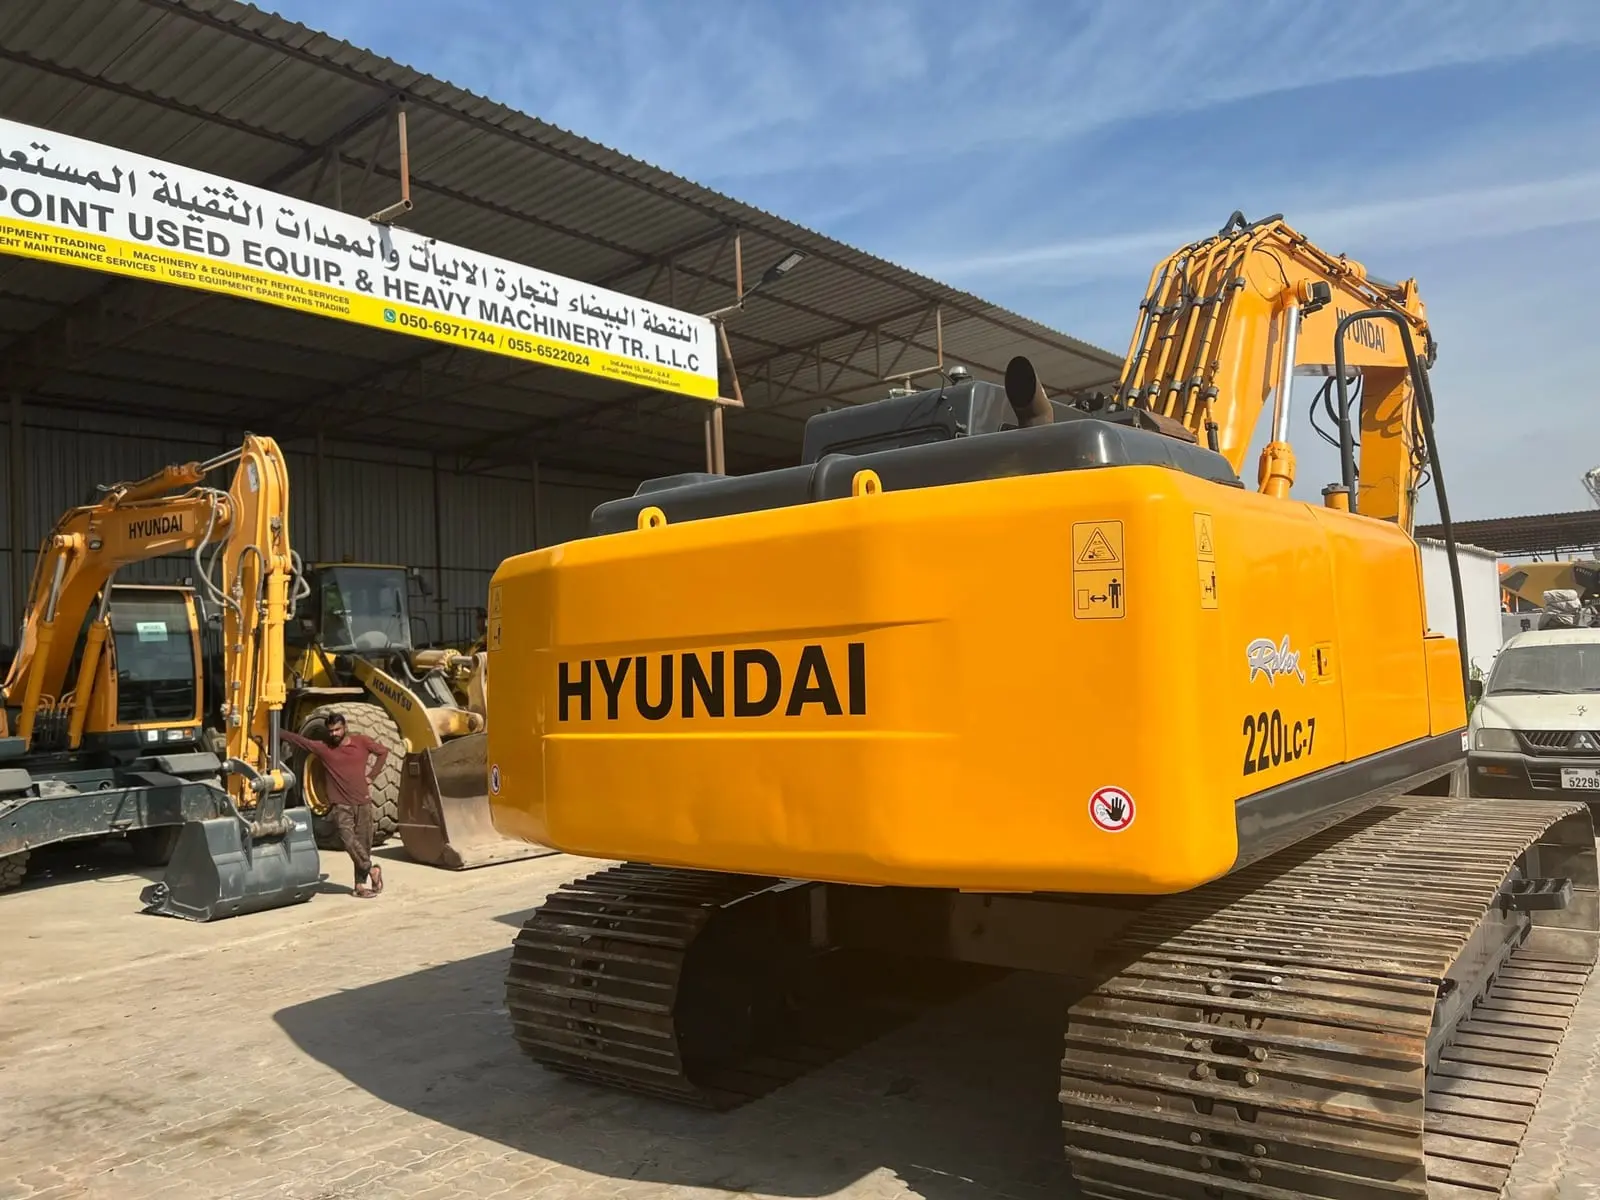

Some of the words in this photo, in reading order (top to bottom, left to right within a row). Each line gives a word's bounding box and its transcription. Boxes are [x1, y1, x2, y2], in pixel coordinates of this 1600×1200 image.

[149, 170, 263, 229] الثقيلة
[0, 225, 49, 241] IPMENT
[53, 235, 106, 253] TRADING
[24, 241, 103, 262] MAINTENANCE
[106, 256, 156, 273] SERVICES
[275, 207, 400, 272] والمعدات
[0, 185, 114, 232] OINT
[128, 212, 230, 257] USED
[243, 240, 345, 286] EQUIP.
[355, 269, 374, 293] &
[383, 275, 471, 315] HEAVY
[479, 300, 612, 350] MACHINERY
[618, 335, 649, 360] TR.
[655, 345, 699, 372] L.L.C
[133, 251, 198, 270] MACHINERY
[201, 265, 208, 273] &
[211, 267, 268, 286] EQUIPMENT
[271, 280, 305, 295] RENTAL
[308, 289, 350, 305] SERVICES
[169, 269, 196, 280] USED
[198, 275, 253, 293] EQUIPMENT
[256, 287, 284, 299] SPARE
[315, 301, 350, 314] TRADING
[495, 267, 559, 308] لتجارة
[568, 294, 636, 330] البيضاء
[642, 308, 697, 344] النقطة
[400, 312, 495, 345] 050-6971744
[507, 337, 590, 366] 055-6522024
[129, 513, 183, 539] HYUNDAI
[372, 676, 412, 711] KOMATSU
[559, 643, 866, 721] HYUNDAI
[1243, 709, 1315, 776] 220LC-7
